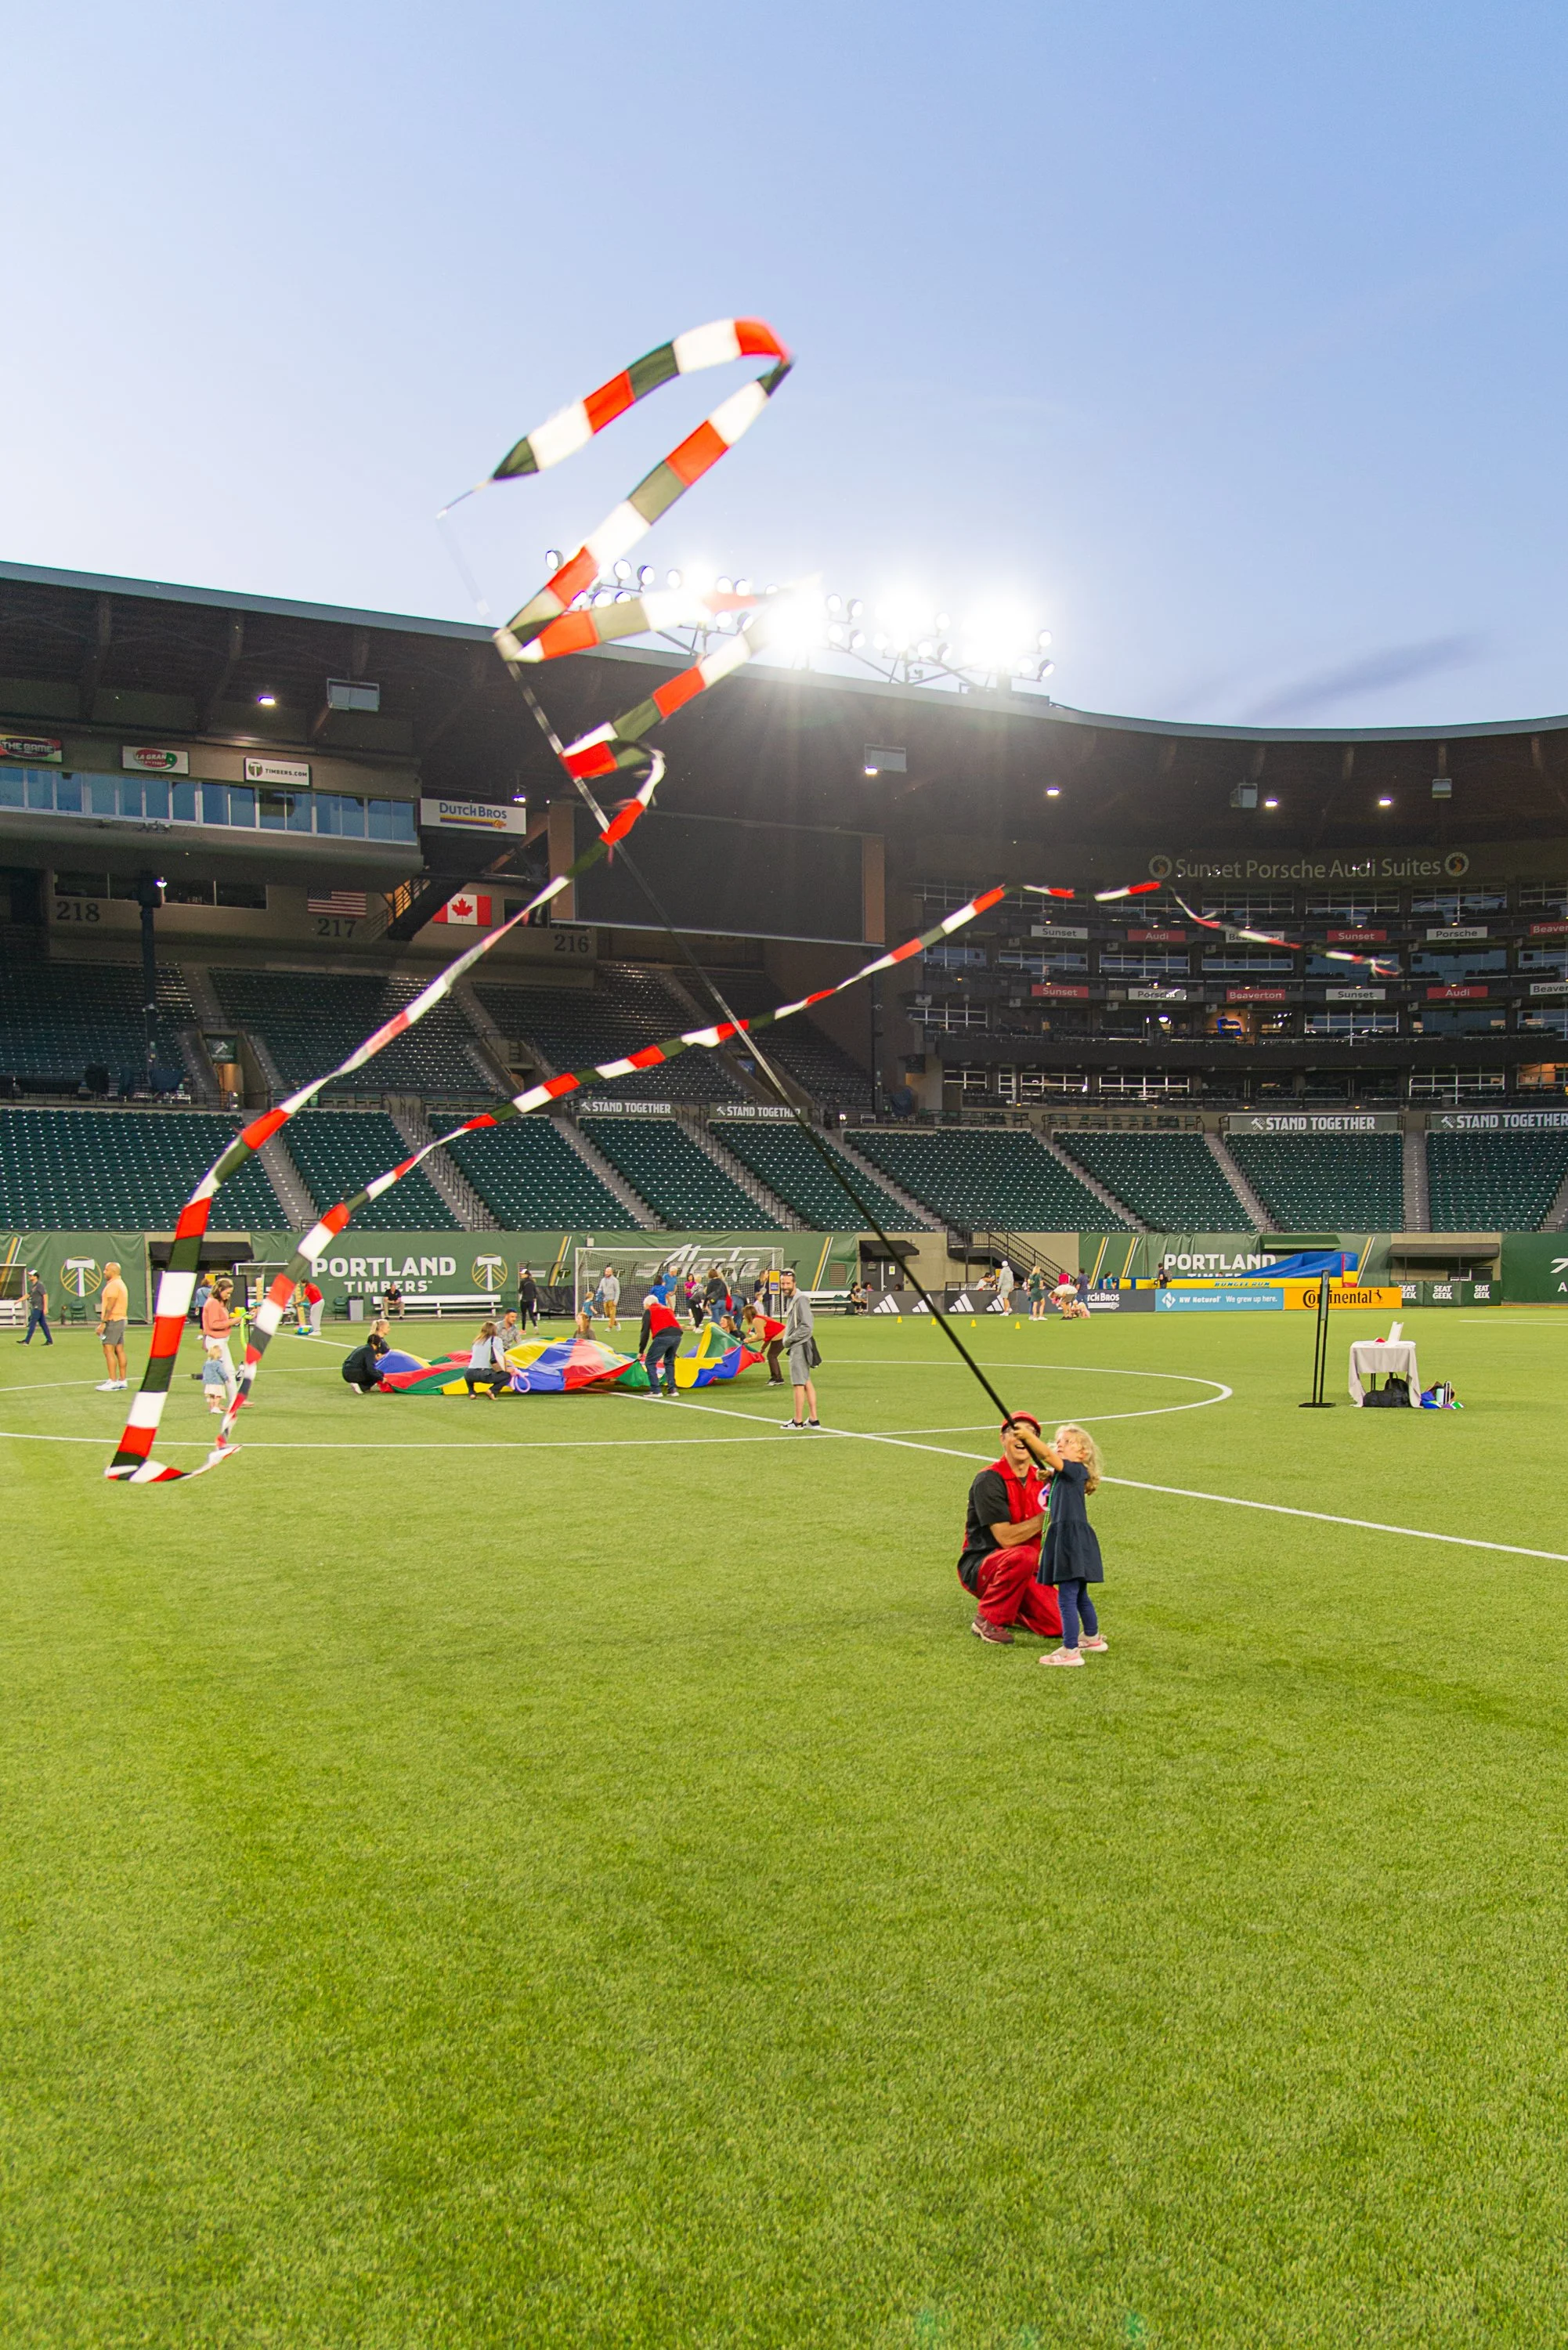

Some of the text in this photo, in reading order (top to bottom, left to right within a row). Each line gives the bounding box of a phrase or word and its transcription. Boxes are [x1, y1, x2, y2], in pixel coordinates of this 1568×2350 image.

[2, 741, 23, 750] THE
[265, 768, 307, 777] TIMBERS.COM
[1176, 859, 1440, 878] Sunset Porsche Audi Suites
[56, 902, 100, 922] 218
[318, 918, 357, 938] 217
[1042, 927, 1077, 938] Sunset
[555, 934, 589, 953] 216
[1042, 987, 1078, 996] Sunset
[1338, 990, 1375, 999] Sunset
[1445, 989, 1470, 997] Audi
[592, 1101, 671, 1114] STAND TOGETHER
[727, 1106, 755, 1117] STAND
[1266, 1116, 1375, 1130] STAND TOGETHER
[1457, 1112, 1568, 1128] STAND TOGETHER
[312, 1256, 457, 1278] PORTLAND
[1474, 1284, 1490, 1292] SEAT
